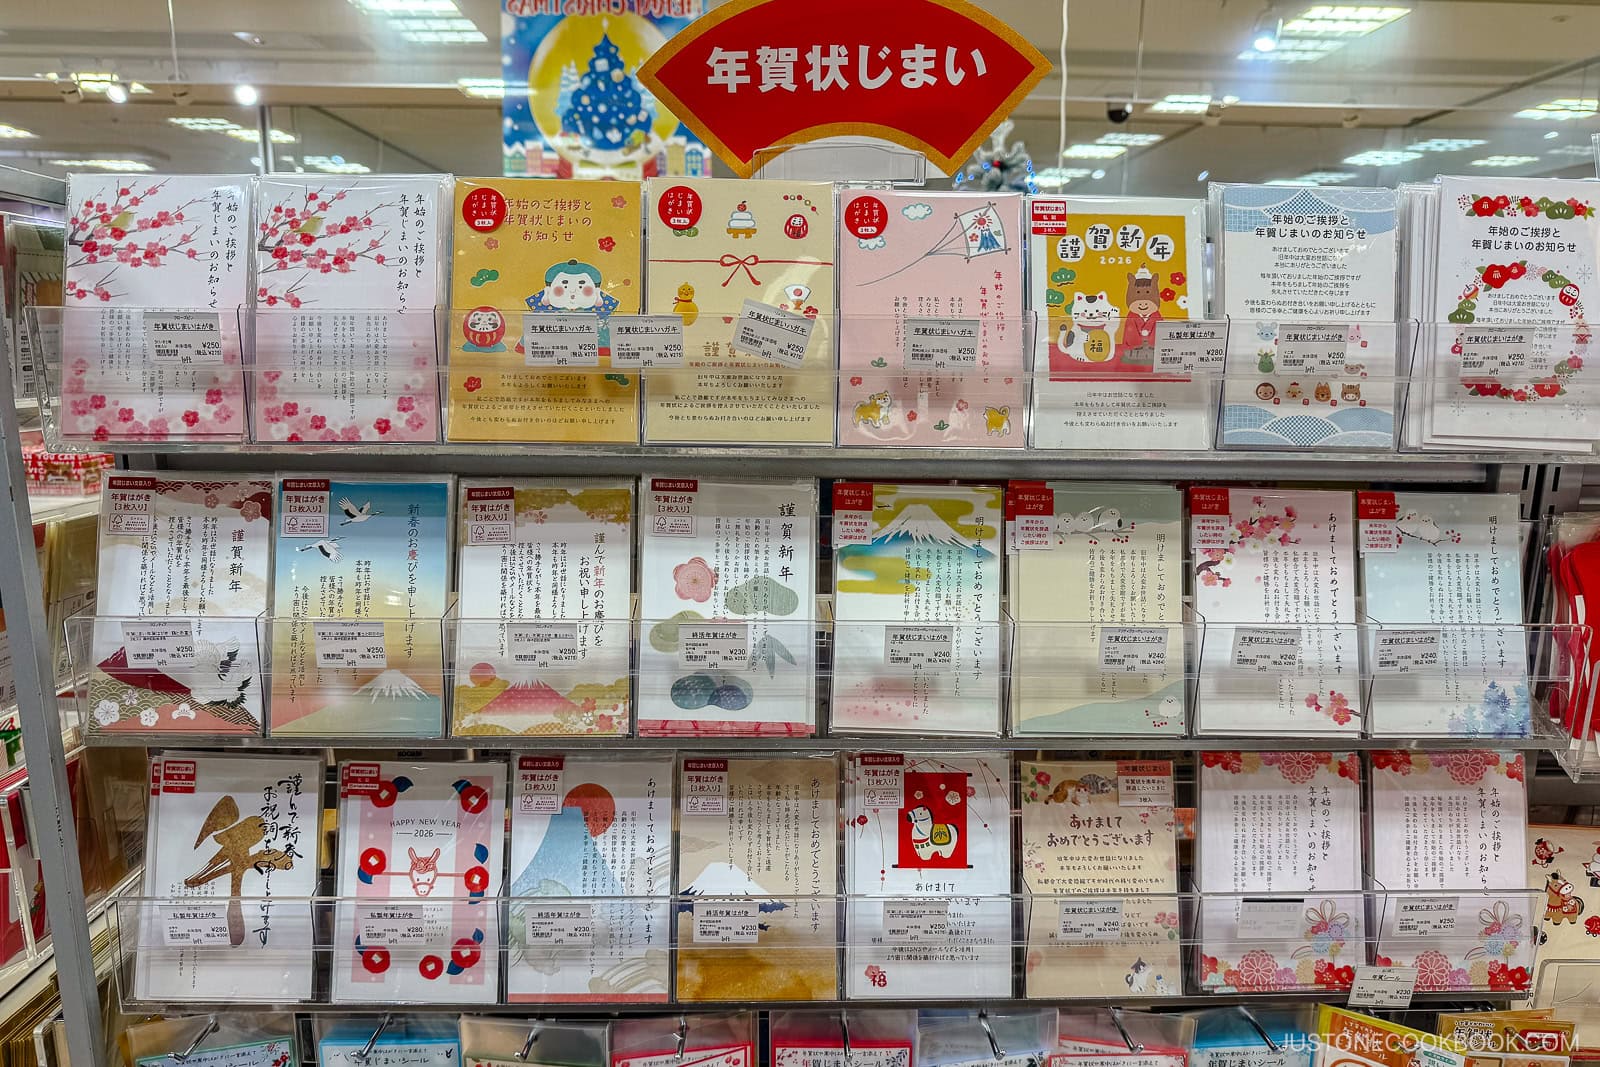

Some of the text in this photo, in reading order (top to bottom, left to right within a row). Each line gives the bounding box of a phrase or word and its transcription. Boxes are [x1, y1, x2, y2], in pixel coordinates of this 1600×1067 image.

[706, 45, 988, 92] 年賀状じまい
[1271, 214, 1350, 226] 年始のご挨拶と
[413, 193, 426, 279] 年始のご挨拶と
[522, 230, 574, 242] お知らせ
[1255, 227, 1367, 241] 年賀じまいのお知らせ
[1487, 225, 1562, 239] 年始のご挨拶と
[1059, 225, 1171, 260] 謹賀新年
[1471, 239, 1577, 253] 年賀じまいのお知らせ
[1099, 256, 1132, 265] 2026
[154, 322, 214, 331] 年賀状じまいはがき
[748, 309, 807, 335] 年賀状じまいハガキ
[531, 324, 592, 332] 年賀状じまいハガキ
[617, 326, 678, 334] 年賀状じまいハガキ
[913, 326, 974, 336] 年賀状じまいハガキ
[1168, 330, 1216, 339] 私製年賀はがき
[1285, 333, 1343, 342] 年賀状じまいはがき
[1466, 335, 1524, 344] 年賀状じまいはがき
[1089, 340, 1103, 353] 福
[111, 493, 152, 502] 年賀はがき
[286, 495, 325, 504] 年賀はがき
[654, 495, 693, 504] 年賀はがき
[471, 504, 511, 512] 年賀はがき
[777, 502, 797, 583] 謹賀新年
[892, 633, 949, 642] 年賀状じまいはがき
[1107, 635, 1163, 643] 年賀状じまいはがき
[390, 818, 462, 829] HAPPY NEW YEAR
[1070, 813, 1122, 830] あけまして
[1320, 786, 1331, 862] 年始のご挨拶と
[1490, 787, 1502, 863] 年始のご挨拶と
[413, 829, 434, 838] 2026
[1047, 829, 1155, 848] おめでとうございます
[915, 883, 956, 893] あけまして
